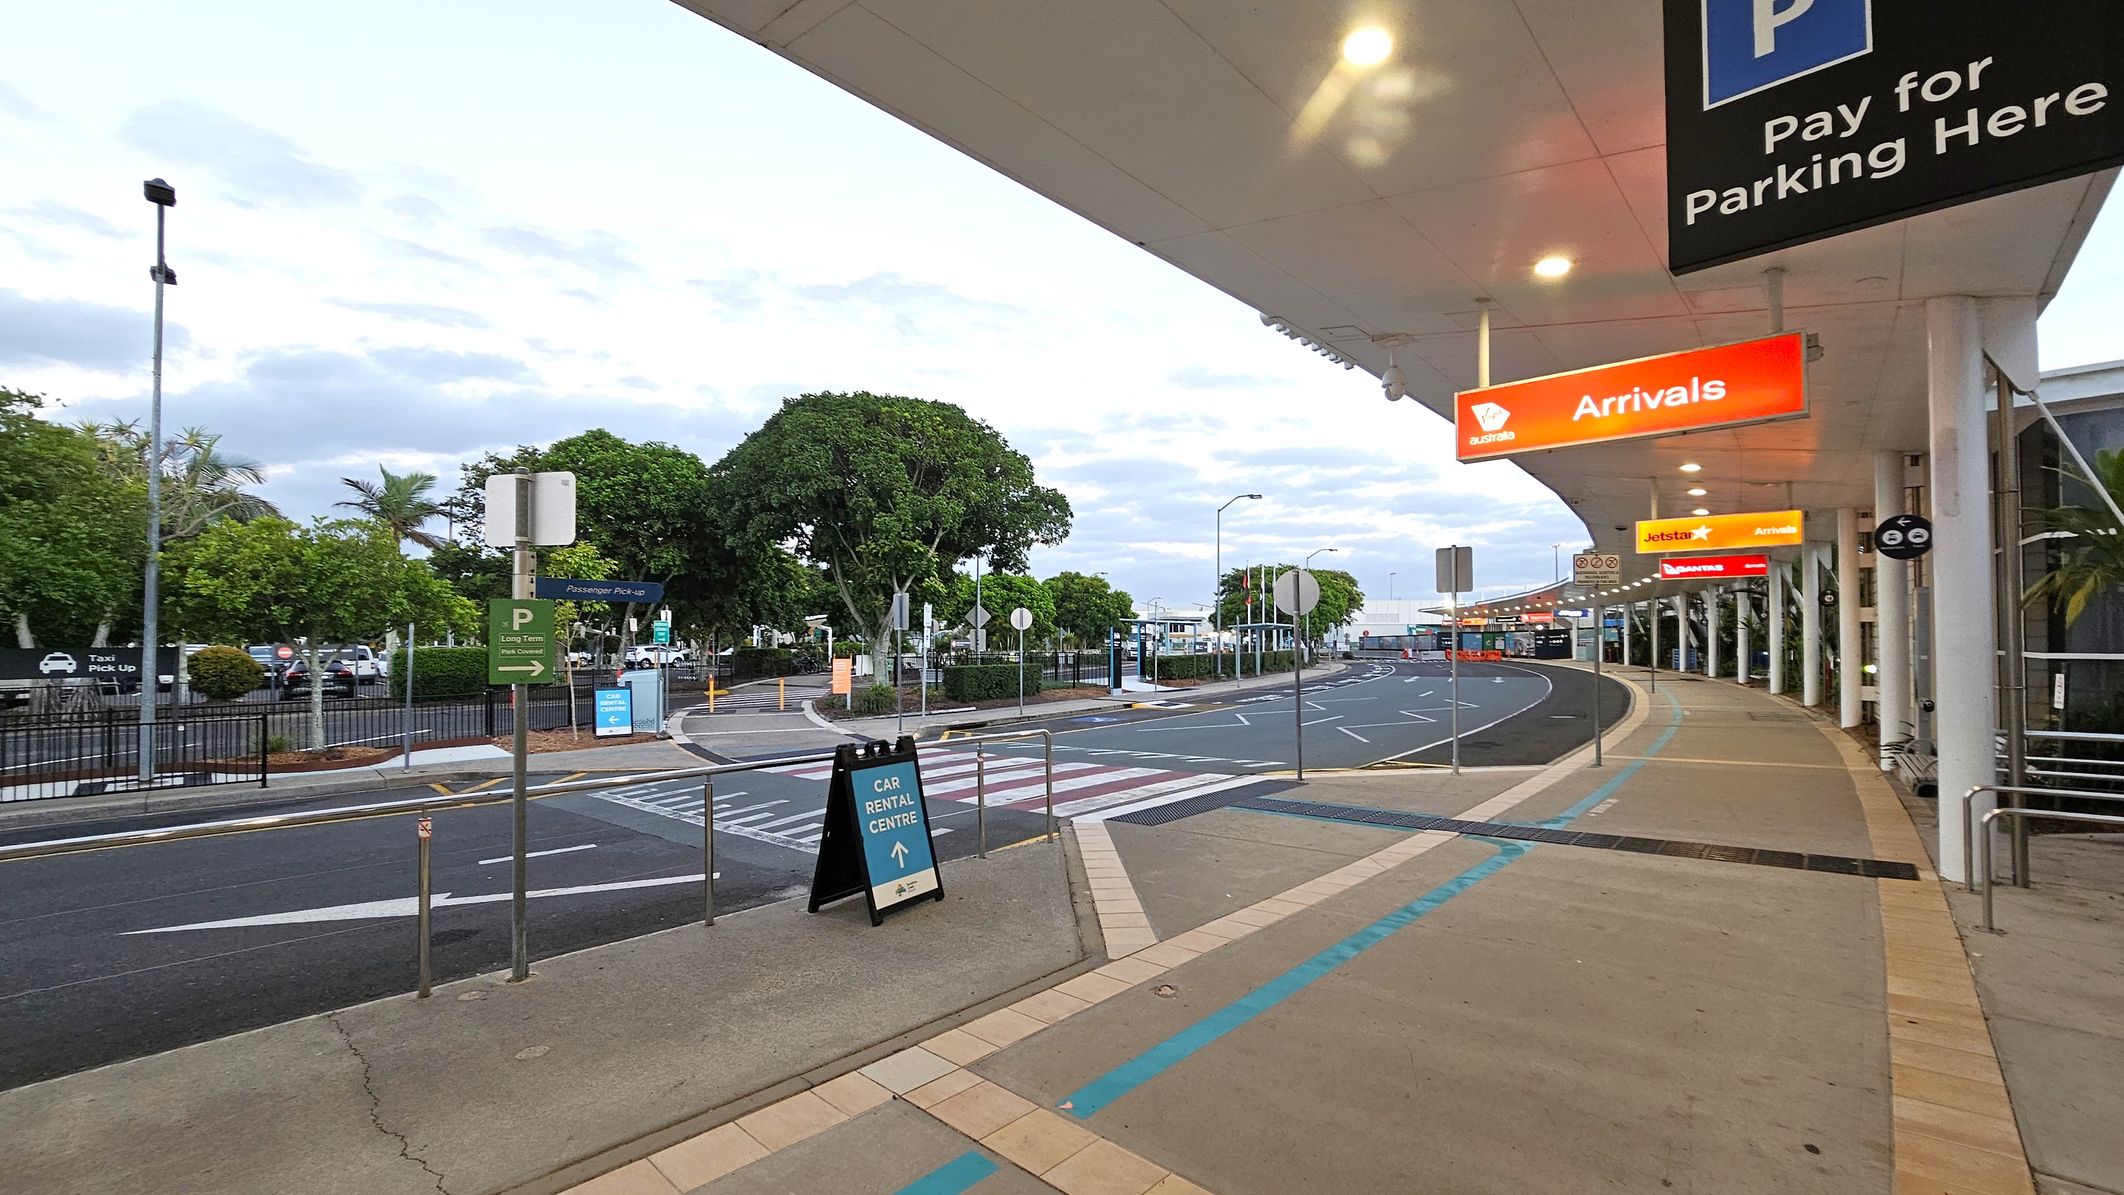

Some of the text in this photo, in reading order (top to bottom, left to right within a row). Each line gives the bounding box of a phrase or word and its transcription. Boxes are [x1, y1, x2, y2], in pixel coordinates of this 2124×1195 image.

[1765, 56, 1993, 155] Pay for
[1686, 82, 2108, 226] Parking Here
[1572, 376, 1727, 422] Arrivals
[1469, 431, 1515, 446] australia
[1644, 525, 1798, 543] Jetstar Arrivals
[1676, 563, 1724, 573] QANTAS
[566, 584, 646, 597] Passenger Pick-up
[512, 608, 534, 631] P
[501, 635, 522, 645] Long
[88, 654, 116, 662] Taxi
[501, 647, 544, 655] Park Covered
[88, 664, 136, 674] Pick Up
[873, 776, 901, 793] CAR
[865, 793, 915, 815] RENTAL
[868, 811, 918, 834] CENTRE
